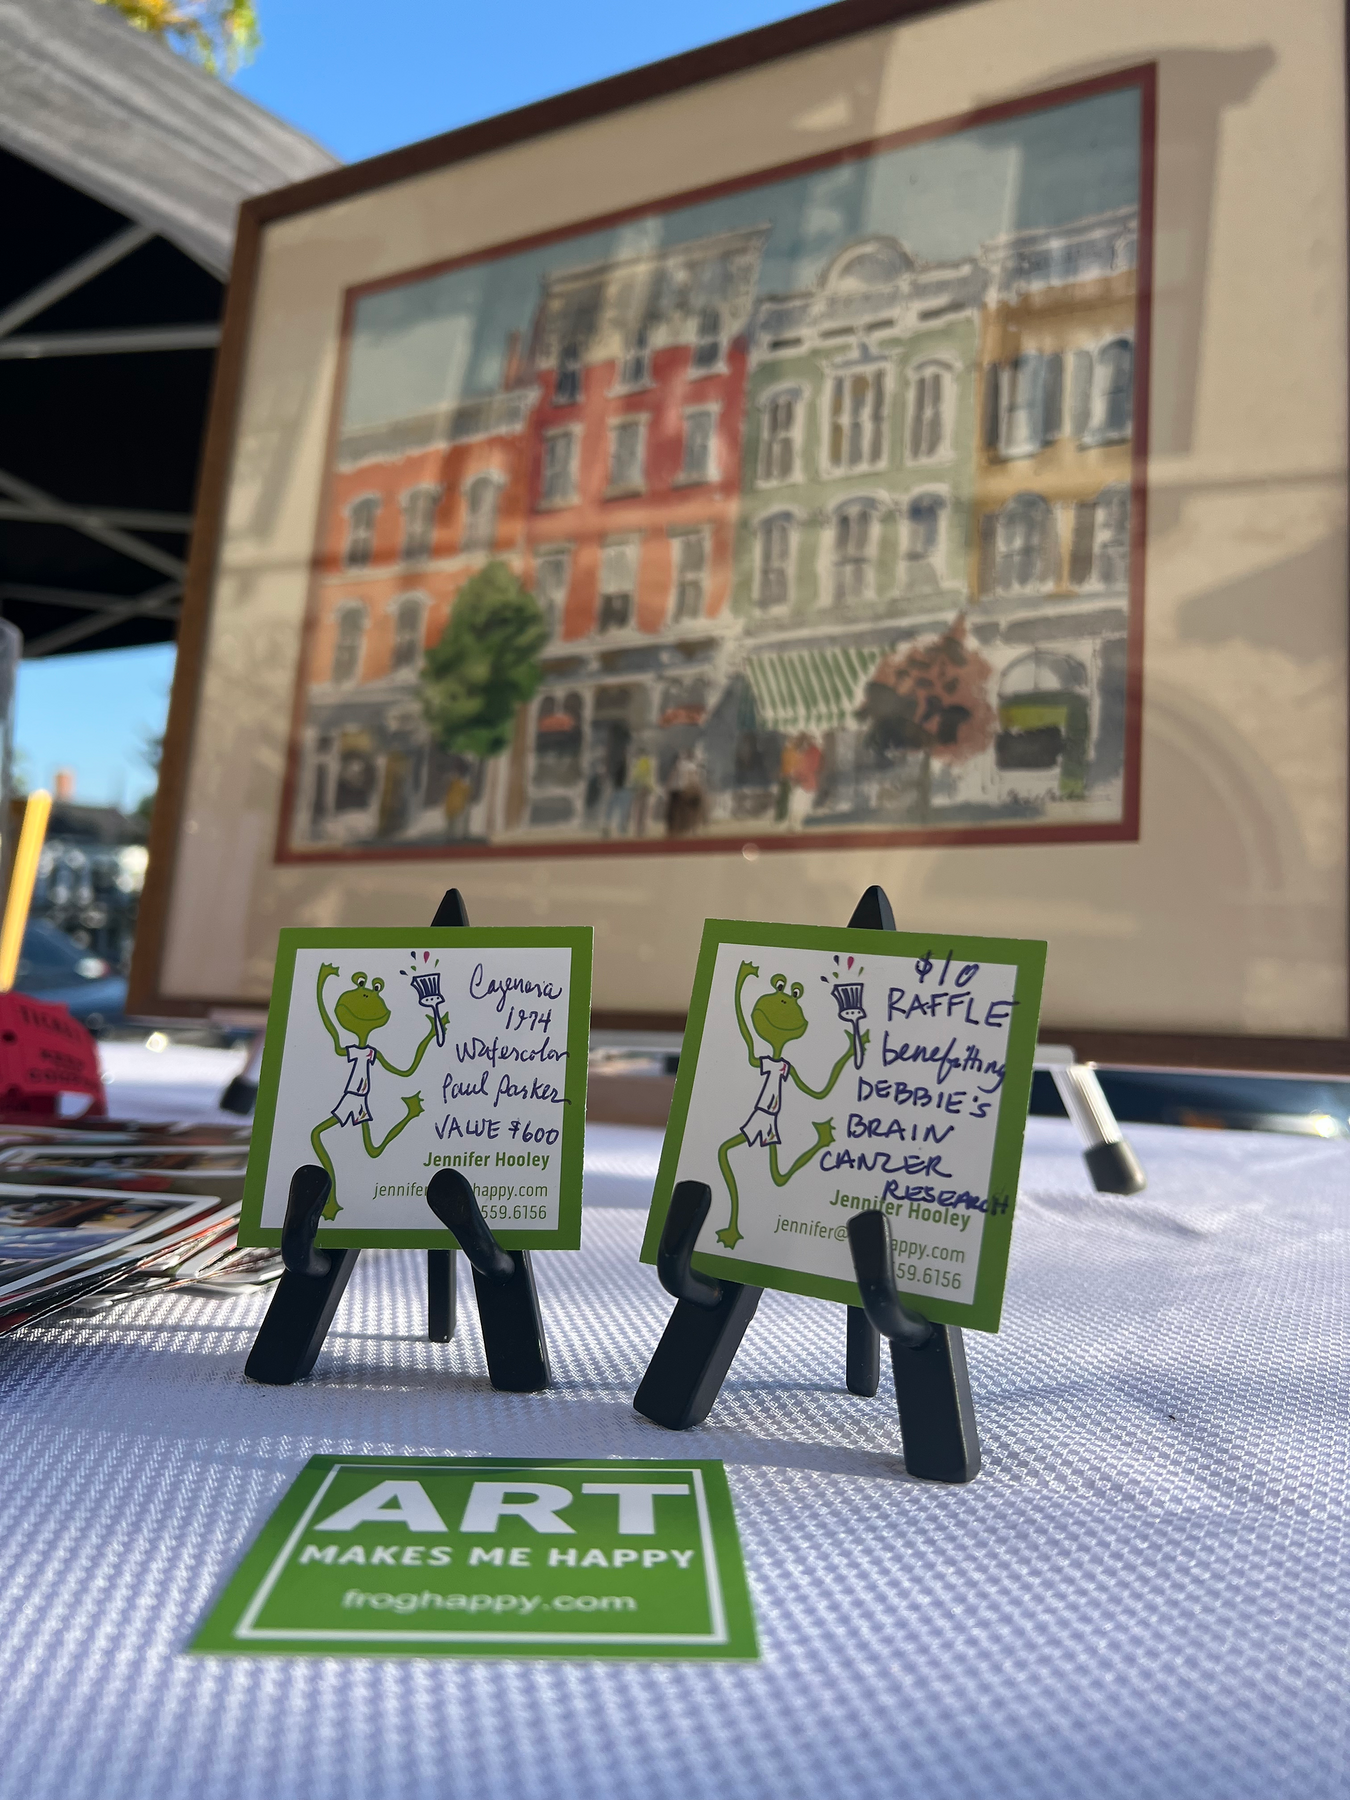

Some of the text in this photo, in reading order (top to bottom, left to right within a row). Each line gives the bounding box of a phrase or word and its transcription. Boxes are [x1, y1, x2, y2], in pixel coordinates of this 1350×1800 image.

[915, 949, 980, 988] $10
[505, 1006, 553, 1034] 1974
[887, 987, 1022, 1028] RAFFLE
[455, 1036, 571, 1068] Watercolor
[442, 1070, 572, 1108] Paul Parker
[434, 1114, 560, 1146] VALUE $600
[846, 1113, 956, 1144] BRAIN
[423, 1152, 551, 1171] Jennifer Hooley
[829, 1189, 972, 1233] Jennifer Hooley
[882, 1178, 1010, 1217] RESEARCH
[893, 1261, 962, 1291] 59.6156
[312, 1479, 691, 1535] ART
[299, 1544, 696, 1570] MAKES ME HAPPY
[341, 1587, 639, 1617] froghappy.com
